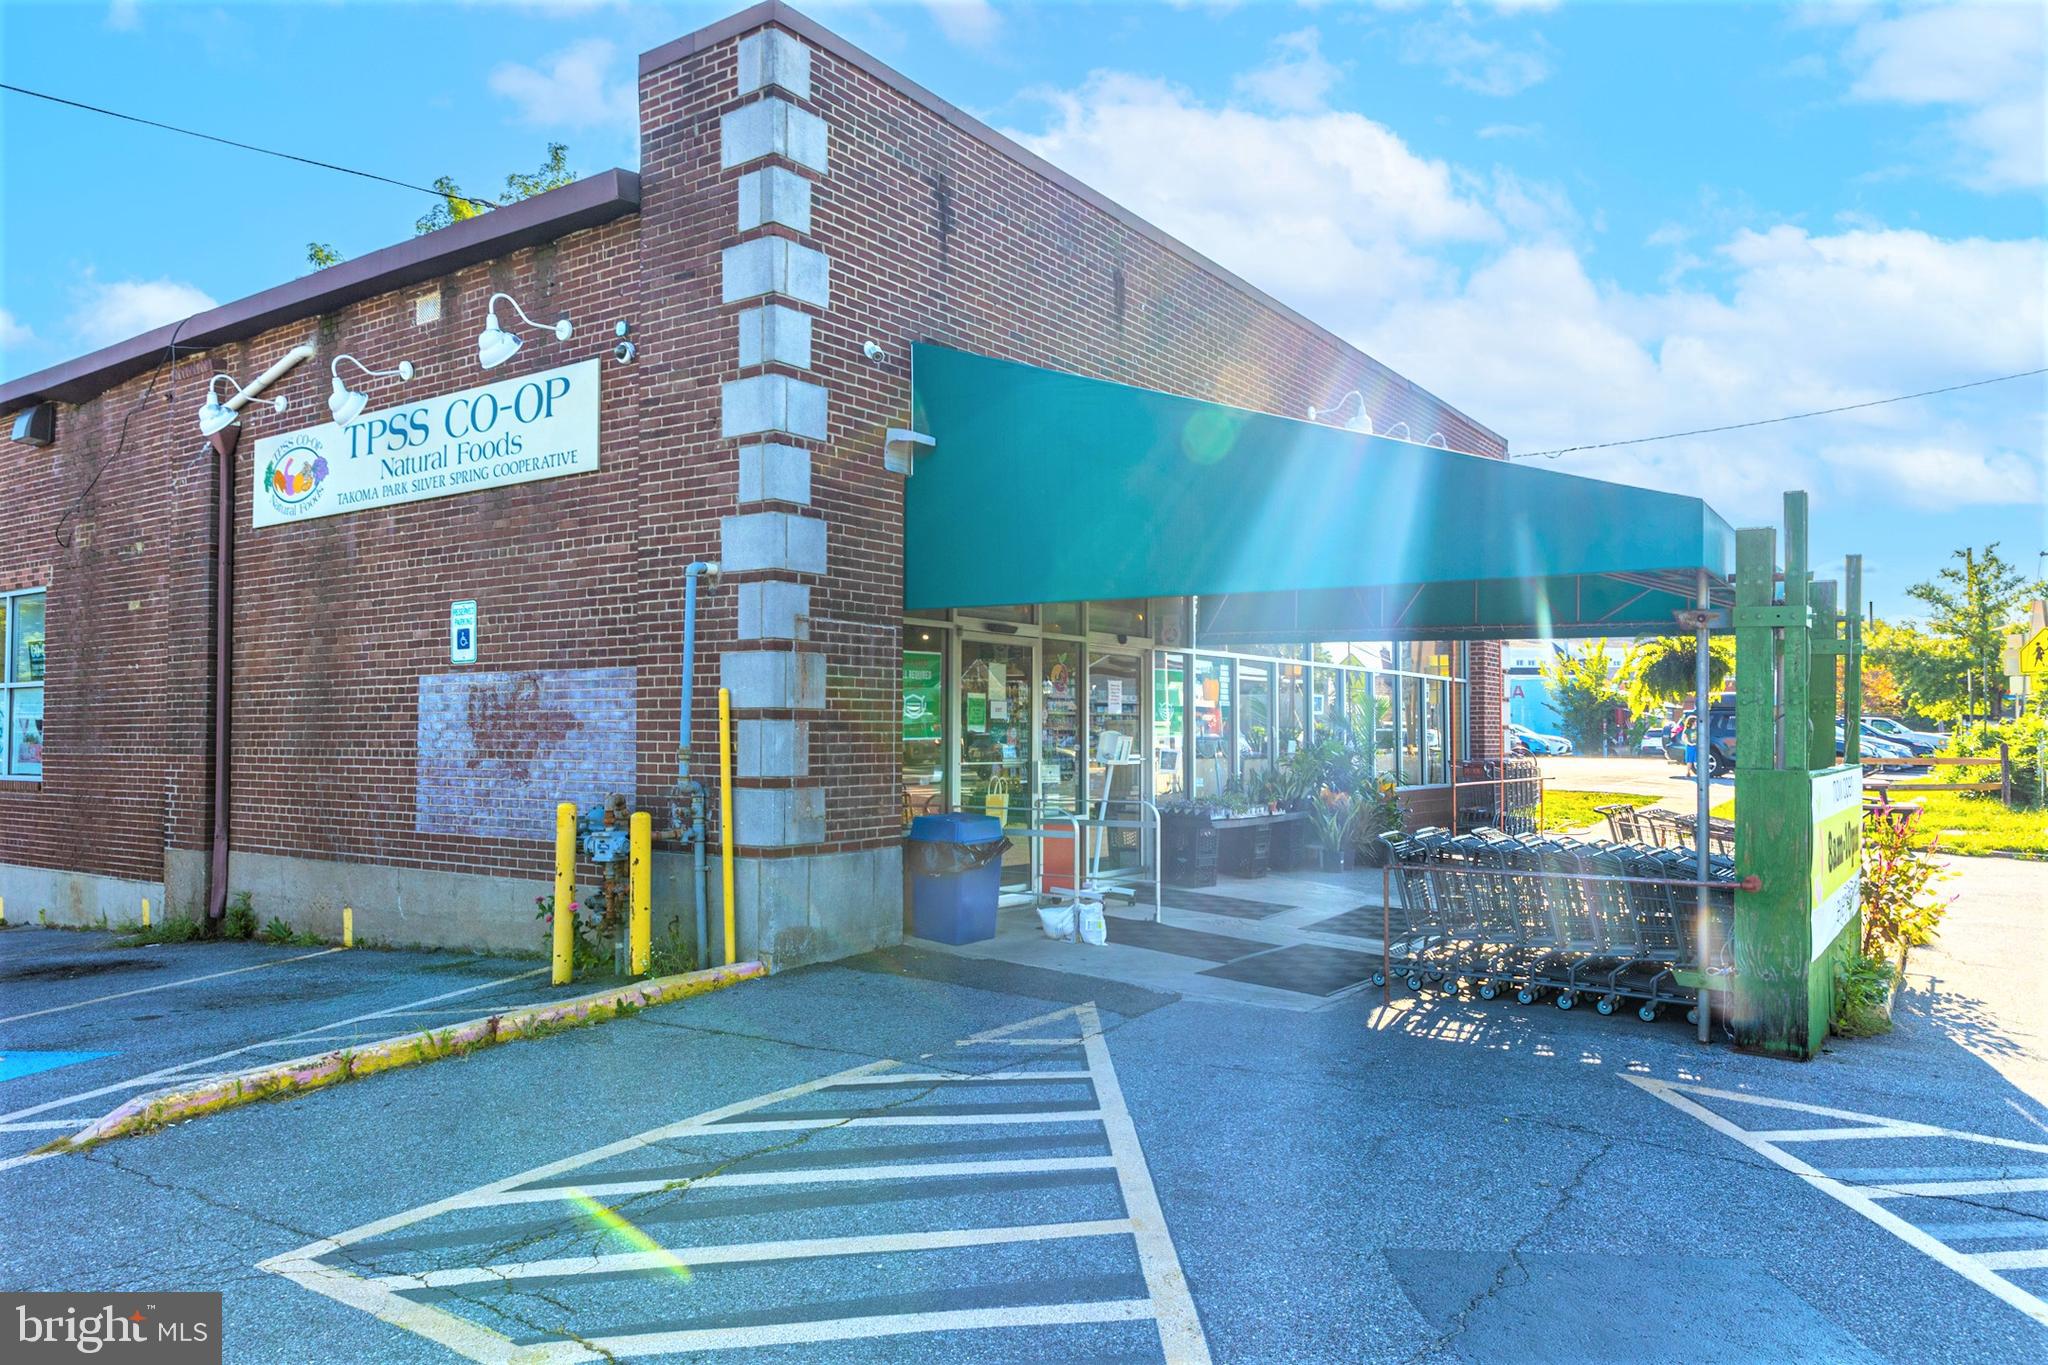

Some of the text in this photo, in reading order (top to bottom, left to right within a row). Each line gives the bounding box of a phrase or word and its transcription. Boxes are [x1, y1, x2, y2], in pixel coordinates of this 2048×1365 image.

[344, 376, 570, 459] TPSS CO-OP
[337, 449, 578, 505] TAKOMA PARK SILVER SPRING COOPERATIVE
[380, 431, 523, 480] Natural Foods
